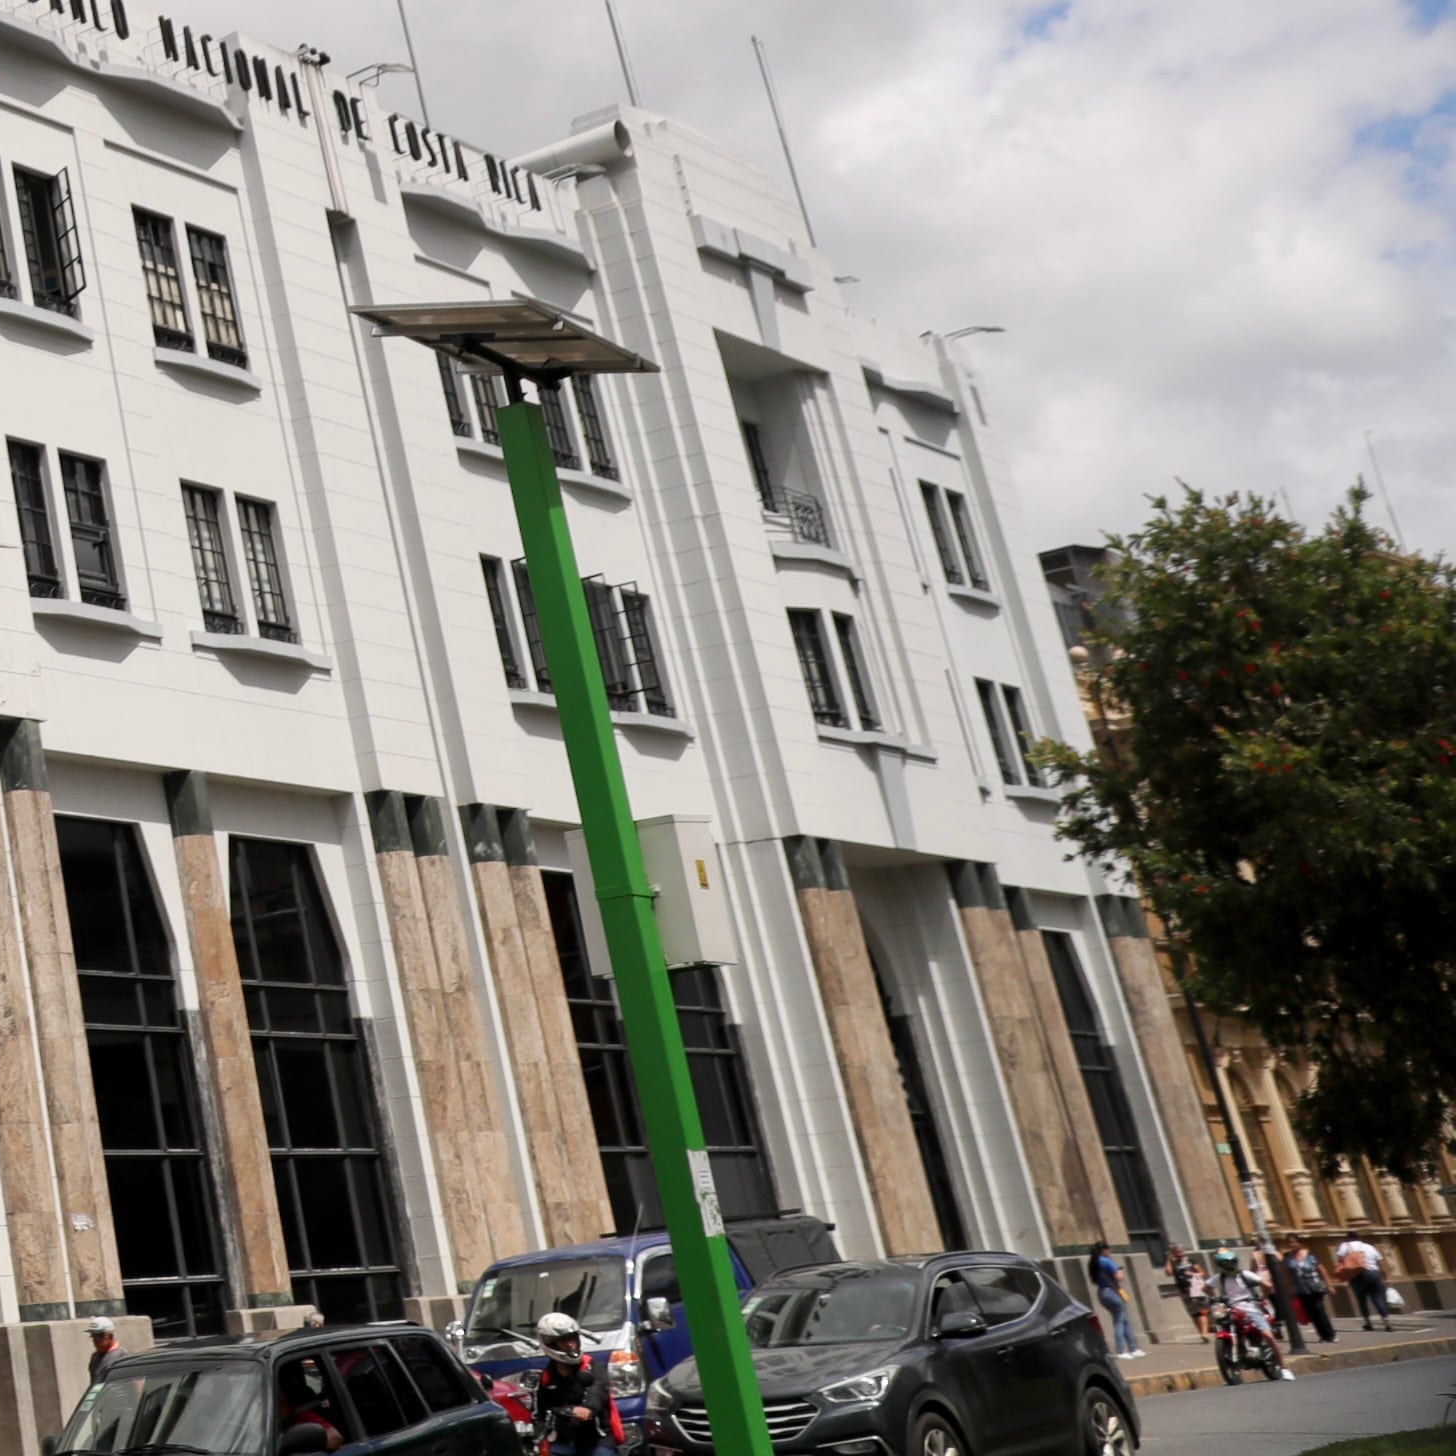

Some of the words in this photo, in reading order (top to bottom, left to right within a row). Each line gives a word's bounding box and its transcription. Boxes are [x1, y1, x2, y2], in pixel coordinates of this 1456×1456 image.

[159, 15, 310, 117] NACIONAL
[333, 89, 370, 140] DE
[388, 112, 469, 182] COSTA
[484, 153, 541, 211] RICA
